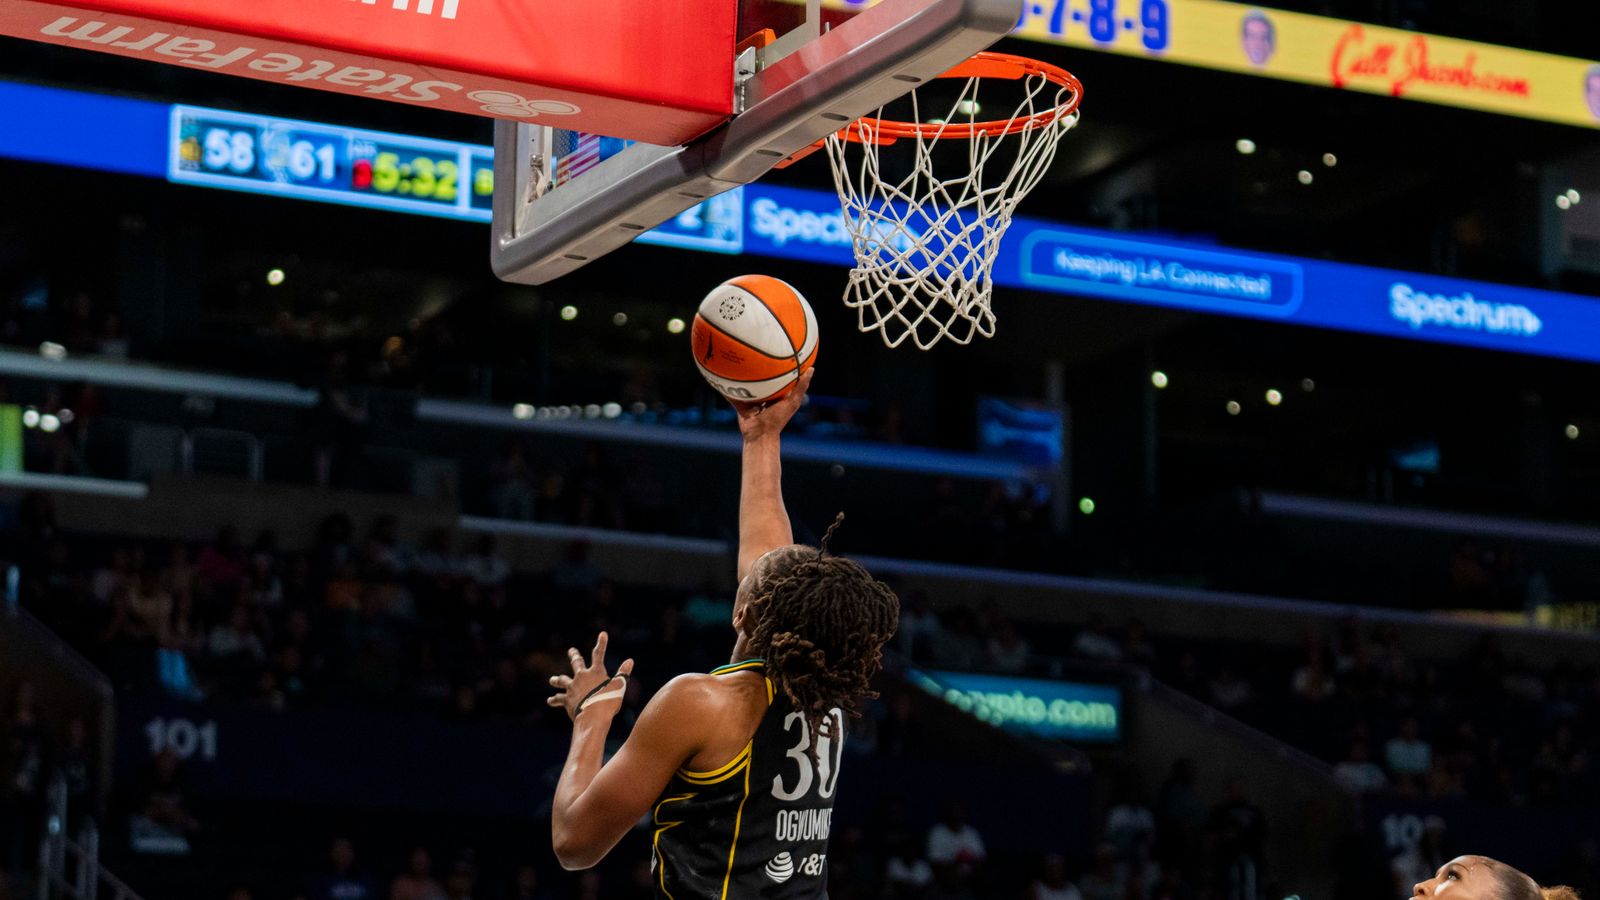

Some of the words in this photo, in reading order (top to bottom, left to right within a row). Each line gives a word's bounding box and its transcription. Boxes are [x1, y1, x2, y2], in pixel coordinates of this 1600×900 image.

[204, 128, 254, 172] 58
[289, 140, 335, 181] 61
[373, 151, 459, 200] 5:32
[1389, 282, 1537, 336] Spectrum
[146, 717, 217, 759] 101
[771, 707, 843, 801] 30
